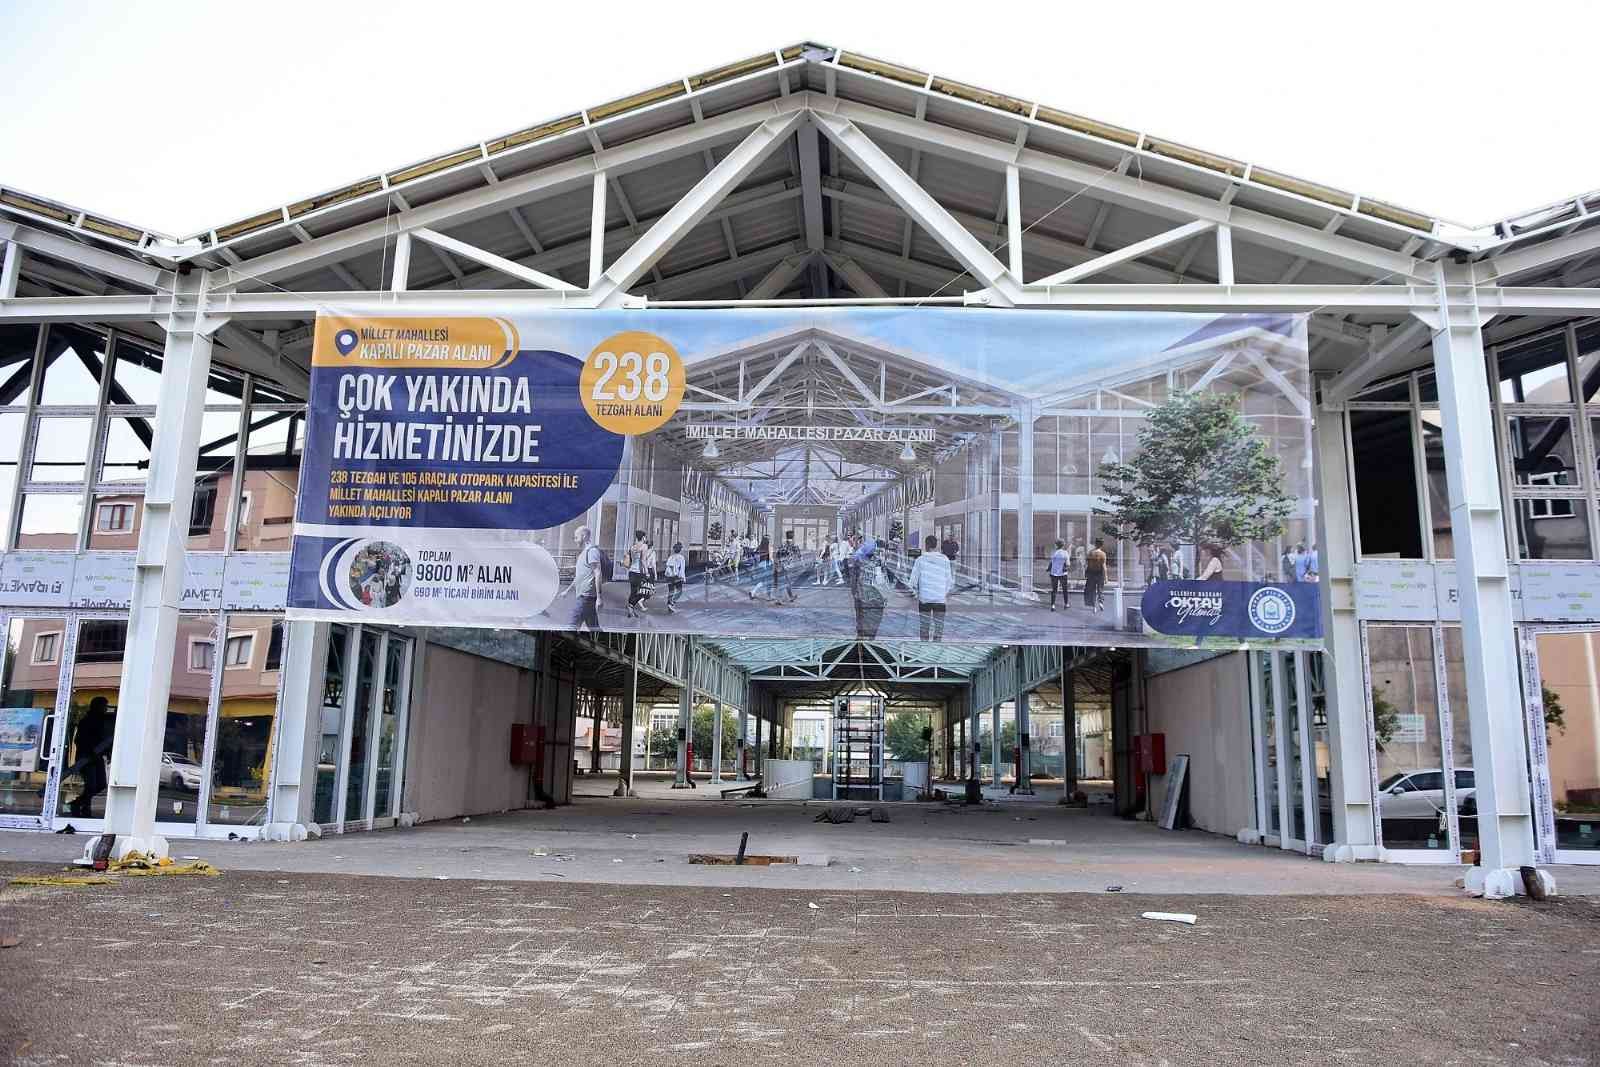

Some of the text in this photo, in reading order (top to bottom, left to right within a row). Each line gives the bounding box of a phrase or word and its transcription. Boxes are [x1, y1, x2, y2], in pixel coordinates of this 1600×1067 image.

[361, 325, 449, 341] MİLLET MAHALLESİ
[360, 343, 491, 361] KAPALI PAZAR ALANI
[592, 351, 670, 402] 238
[338, 374, 531, 418] ÇOK YAKINDA
[596, 403, 663, 417] TEZGAH ALANI
[333, 414, 542, 463] HİZMETİNİZDE
[834, 427, 884, 441] PAZAR
[888, 428, 934, 442] ALANI
[331, 471, 579, 489] 238 TEZGAH VE 105 ARAÇLIK OTOPARK KAPASİTESİ İLE
[330, 486, 513, 504] MİLLET MAHALLESİ KAPALI PAZAR ALANI
[329, 505, 412, 520] YAKINDA AÇILIYOR
[419, 551, 452, 562] TOPLAM
[416, 564, 453, 582] 9800
[477, 566, 512, 583] ALAN
[496, 589, 520, 601] ALANI
